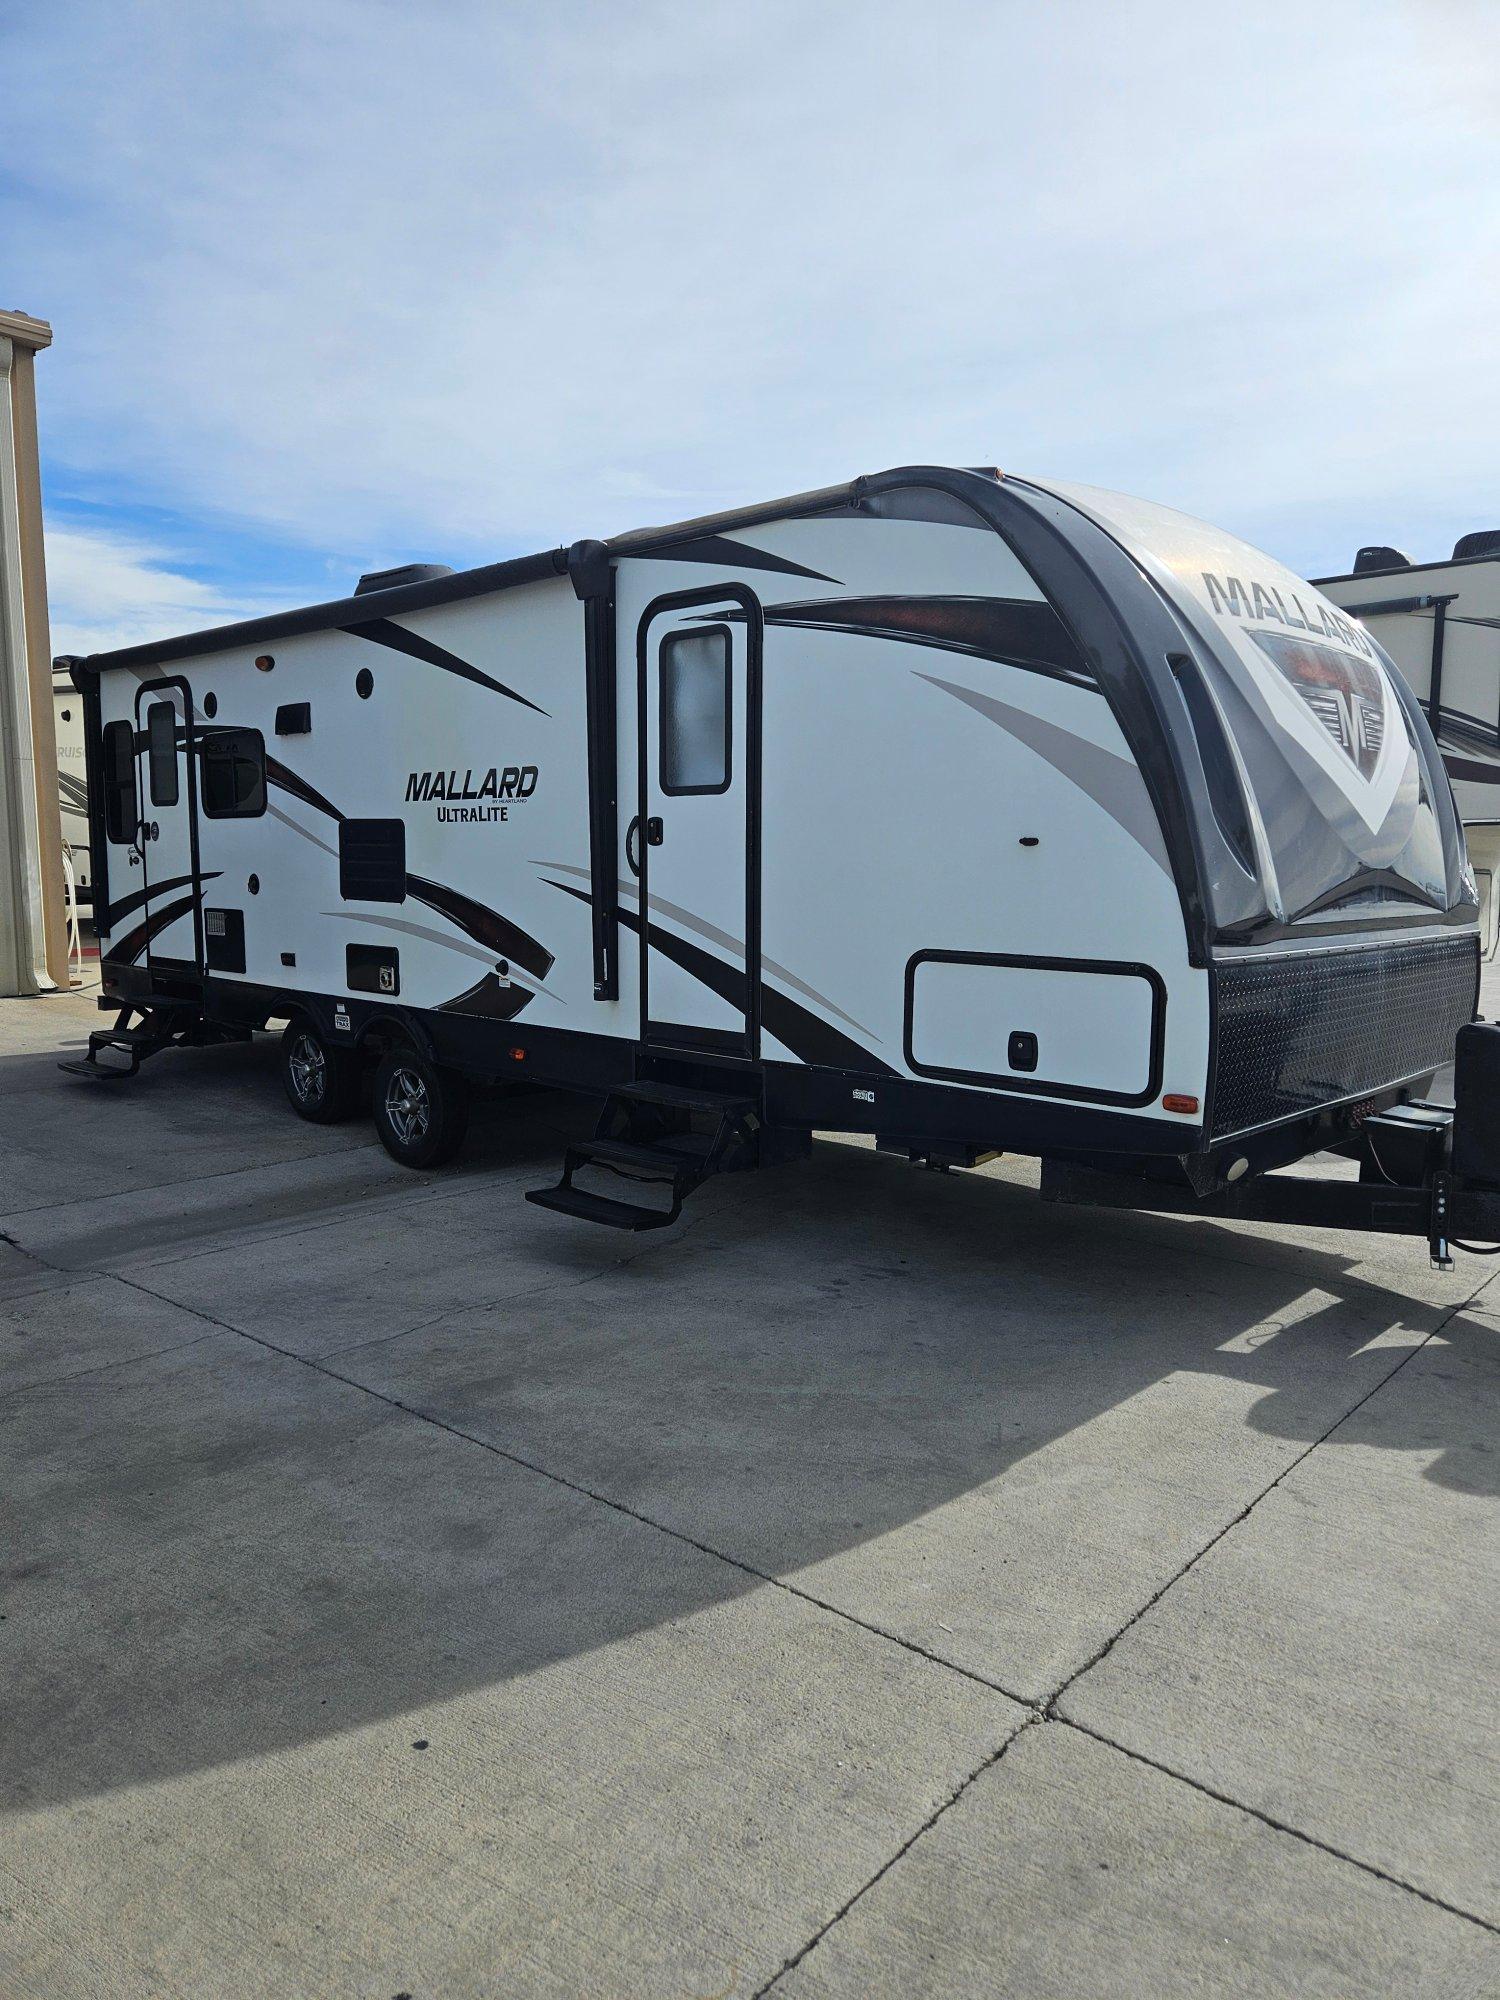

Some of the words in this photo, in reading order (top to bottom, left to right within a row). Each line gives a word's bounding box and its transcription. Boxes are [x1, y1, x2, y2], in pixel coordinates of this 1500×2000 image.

[1201, 572, 1373, 658] MALLARD
[57, 746, 84, 758] RUIS
[405, 766, 539, 801] MALLARD
